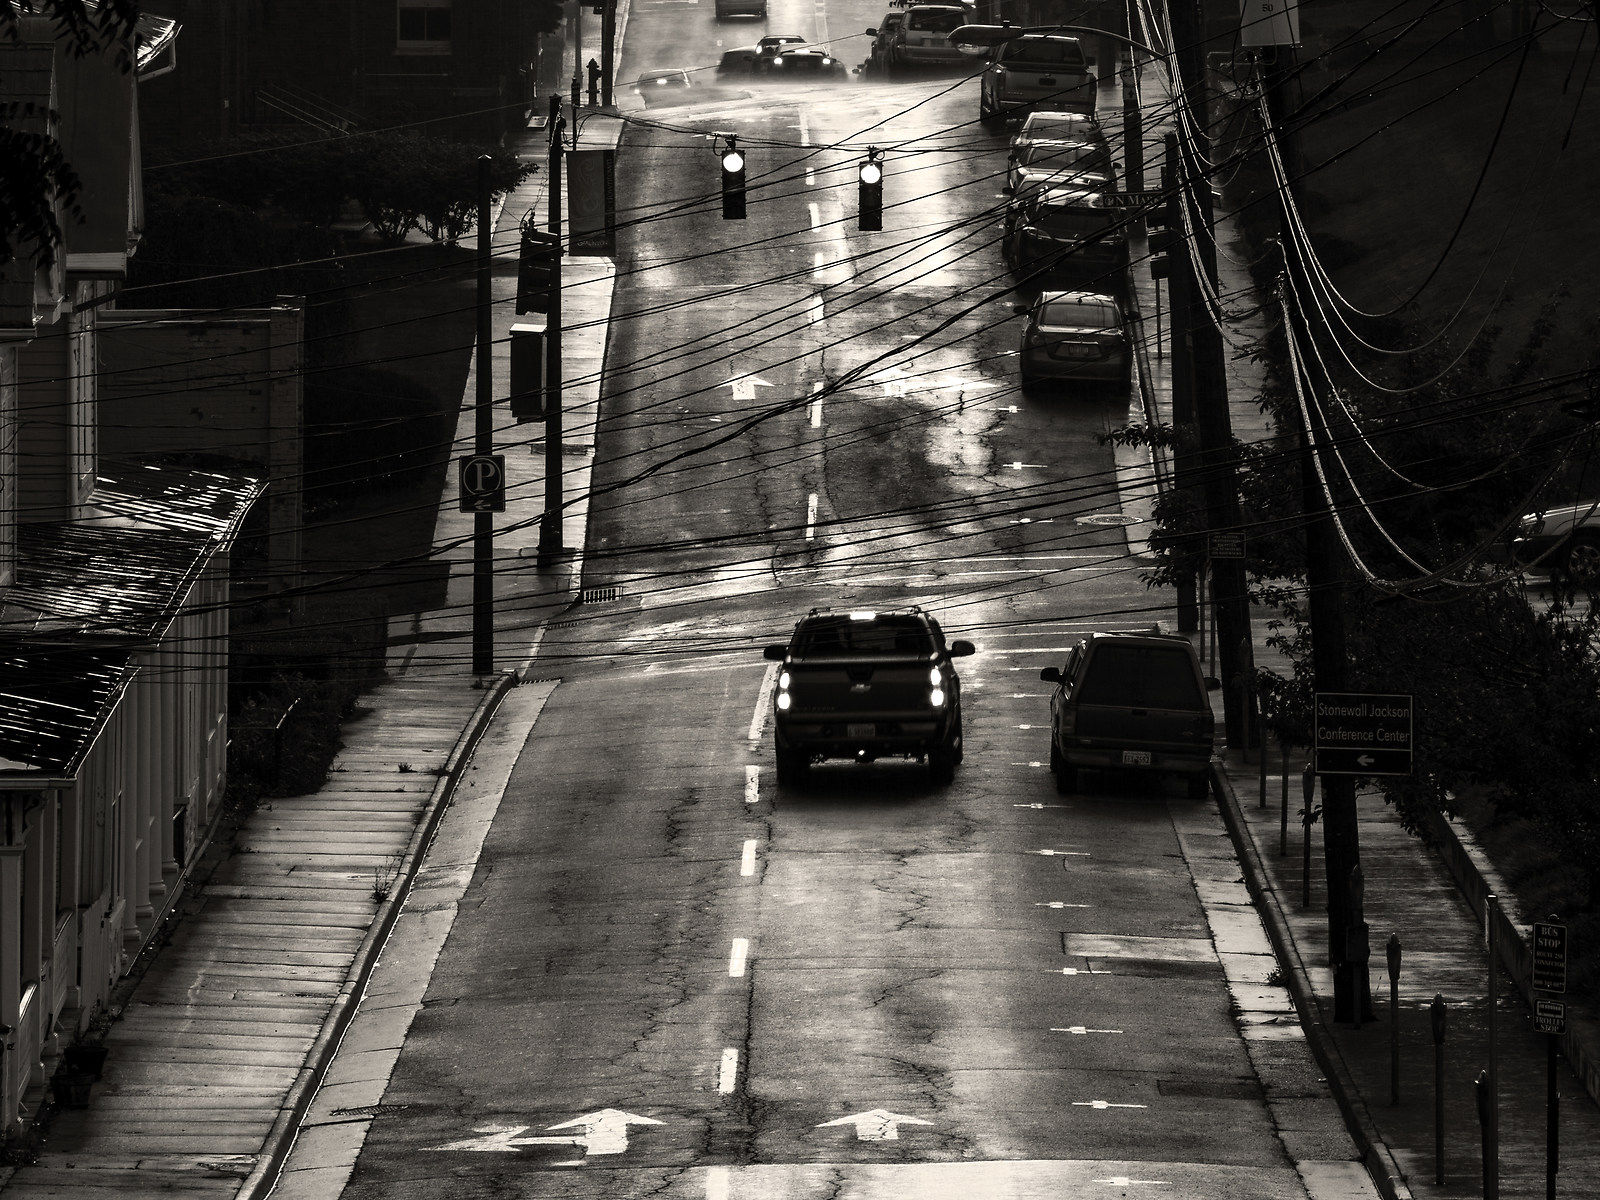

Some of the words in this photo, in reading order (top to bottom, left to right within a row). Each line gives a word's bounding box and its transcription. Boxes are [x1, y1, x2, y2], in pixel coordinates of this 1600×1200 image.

[474, 462, 496, 491] P
[1318, 702, 1367, 717] Stonewall
[1369, 704, 1410, 718] Jackson
[1318, 726, 1374, 741] Conference
[1376, 728, 1411, 742] Center
[1541, 927, 1558, 937] BUS
[1538, 938, 1561, 948] STOP
[1535, 1016, 1565, 1027] TROLLEY
[1540, 1024, 1559, 1033] STOP
